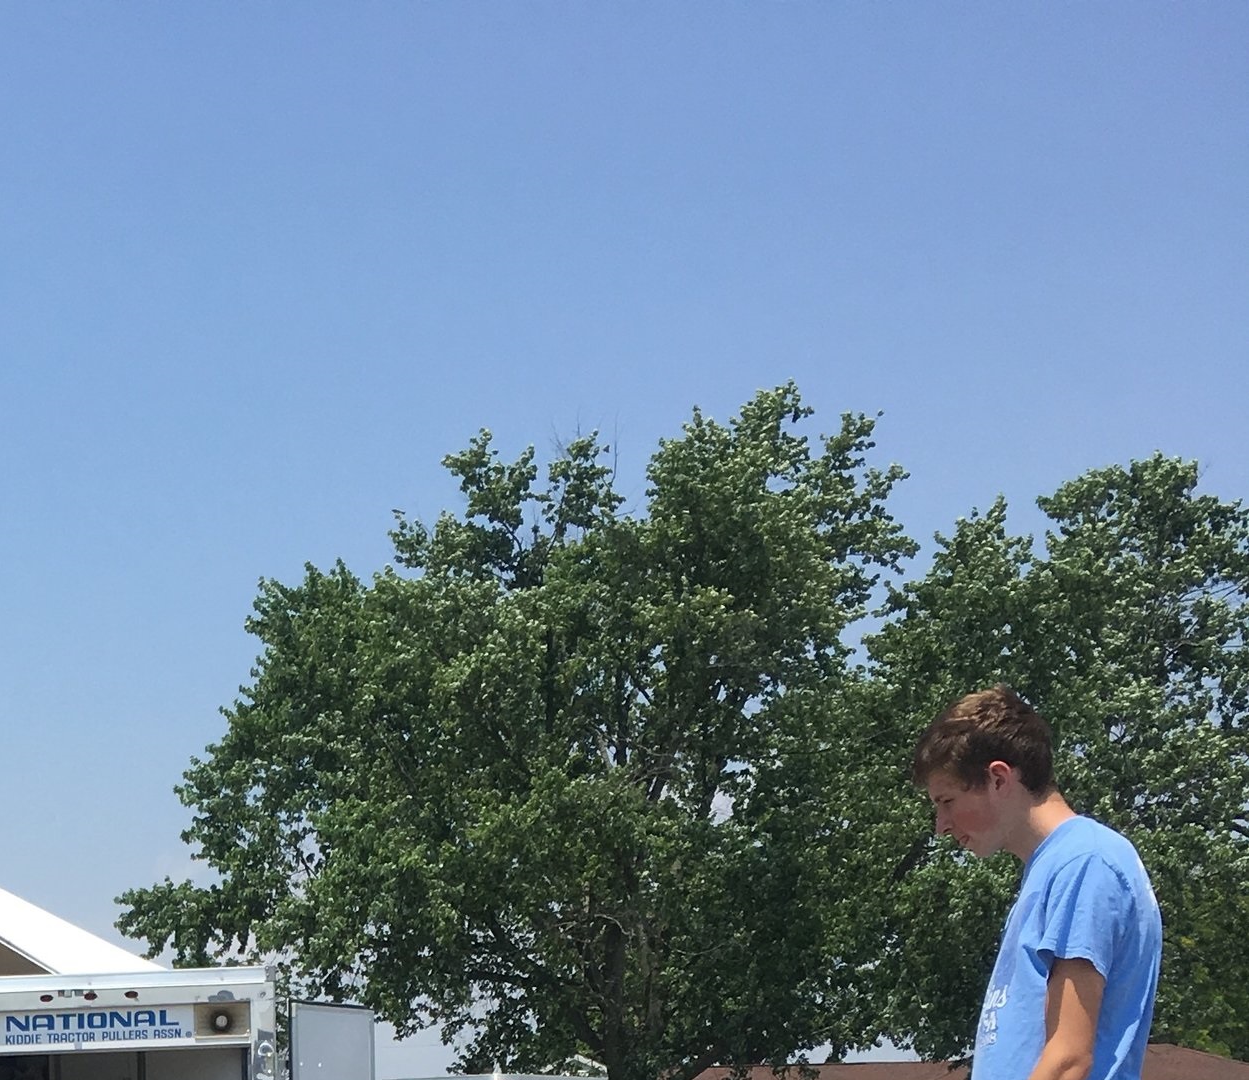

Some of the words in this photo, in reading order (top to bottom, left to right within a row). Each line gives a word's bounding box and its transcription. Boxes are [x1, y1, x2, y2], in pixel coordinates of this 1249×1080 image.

[6, 1010, 180, 1032] NATIONAL
[5, 1034, 42, 1045] KIDDIE
[47, 1032, 95, 1043] TRACTOR
[102, 1030, 148, 1041] PULLERS
